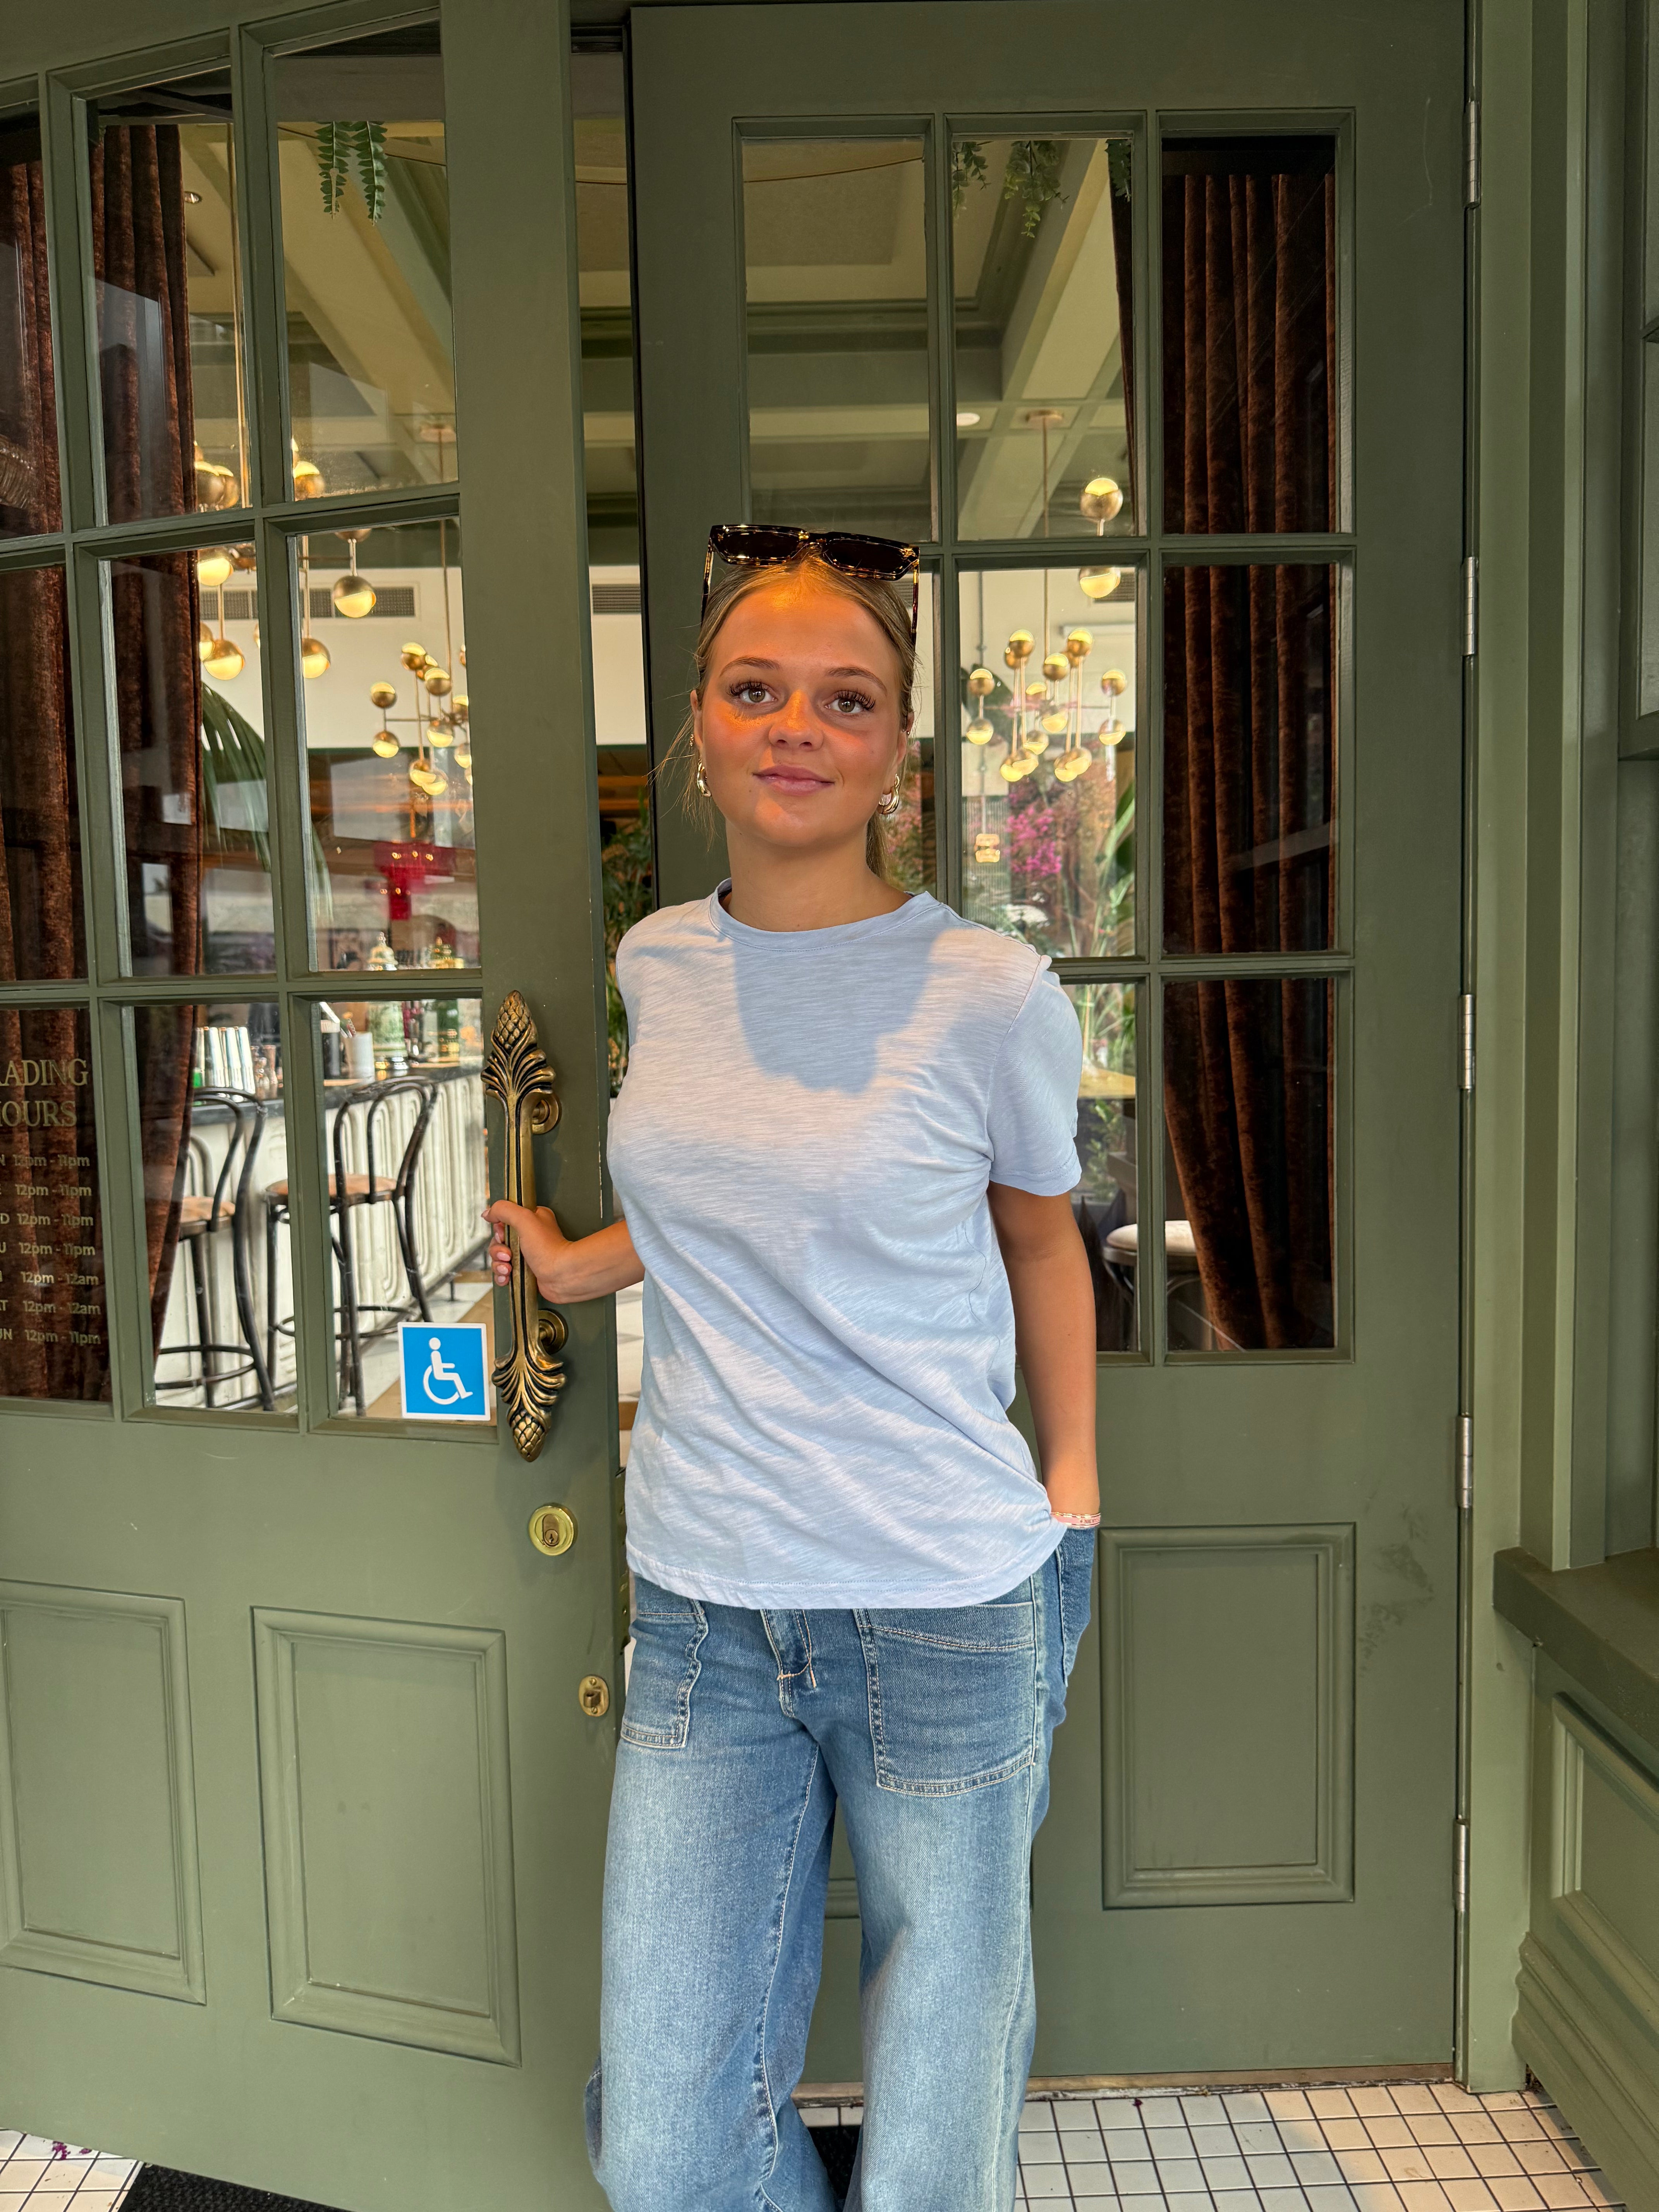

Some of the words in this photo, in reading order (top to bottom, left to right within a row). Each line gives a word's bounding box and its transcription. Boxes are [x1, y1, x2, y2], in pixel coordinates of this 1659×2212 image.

[0, 1058, 89, 1086] ADING
[0, 1100, 77, 1127] OURS
[13, 1154, 47, 1169] 12pm
[58, 1154, 90, 1169] 11pm
[15, 1184, 48, 1199] 12pm
[60, 1184, 92, 1199] 11pm
[17, 1213, 51, 1227] 12pm
[61, 1214, 94, 1228] 11pm
[19, 1242, 52, 1257] 12pm
[63, 1242, 96, 1258] 11pm
[21, 1271, 55, 1286] 12pm
[65, 1273, 99, 1285] 12am
[23, 1300, 56, 1315] 12pm
[68, 1302, 101, 1315] 12am
[25, 1329, 58, 1344] 12pm
[69, 1331, 101, 1346] 11pm
